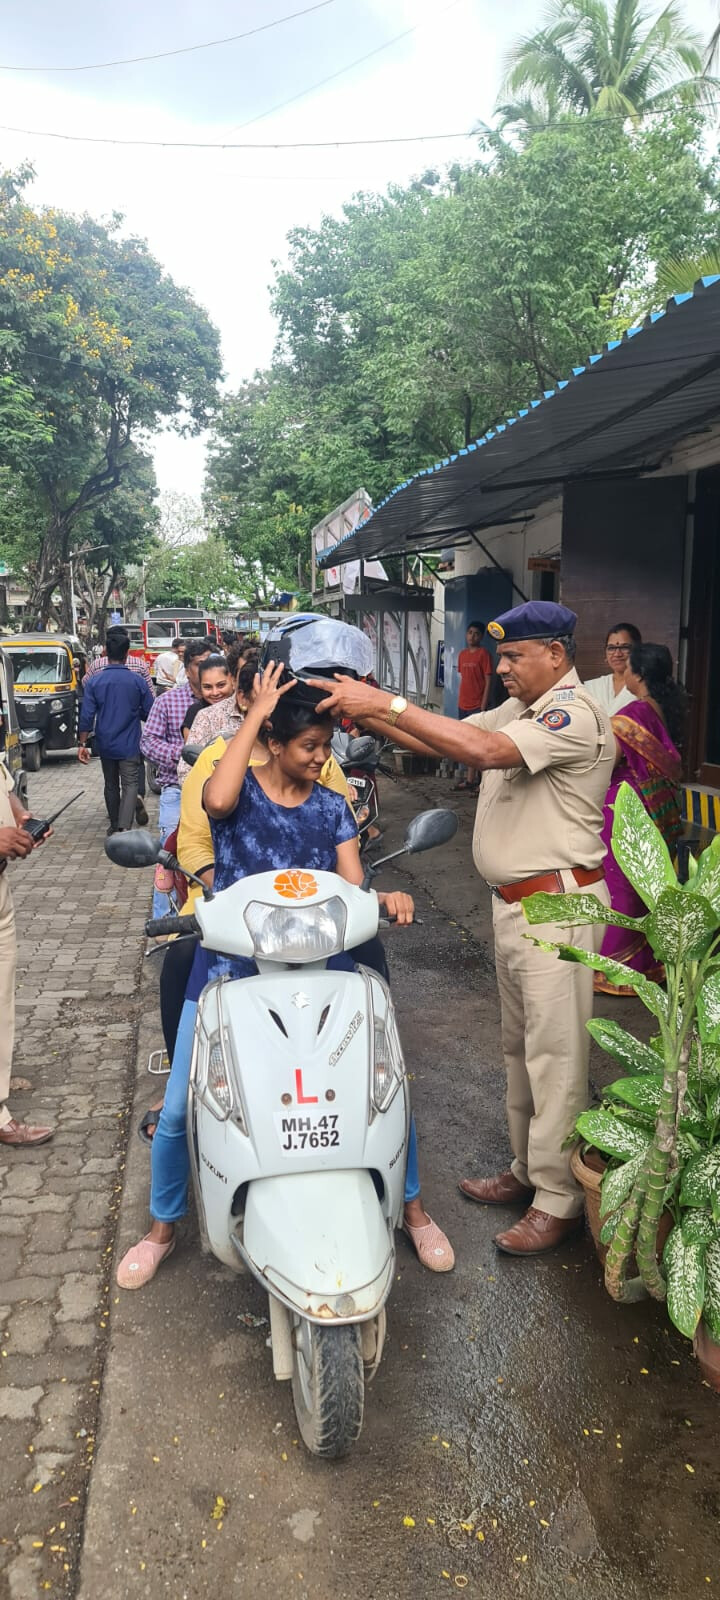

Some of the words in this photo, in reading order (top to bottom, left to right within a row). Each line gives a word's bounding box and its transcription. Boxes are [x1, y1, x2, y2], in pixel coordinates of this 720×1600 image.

[329, 1029, 354, 1067] Access
[295, 1068, 318, 1104] L
[282, 1114, 339, 1133] MH.47
[283, 1130, 340, 1150] J.7652
[201, 1152, 228, 1185] SUZUKI
